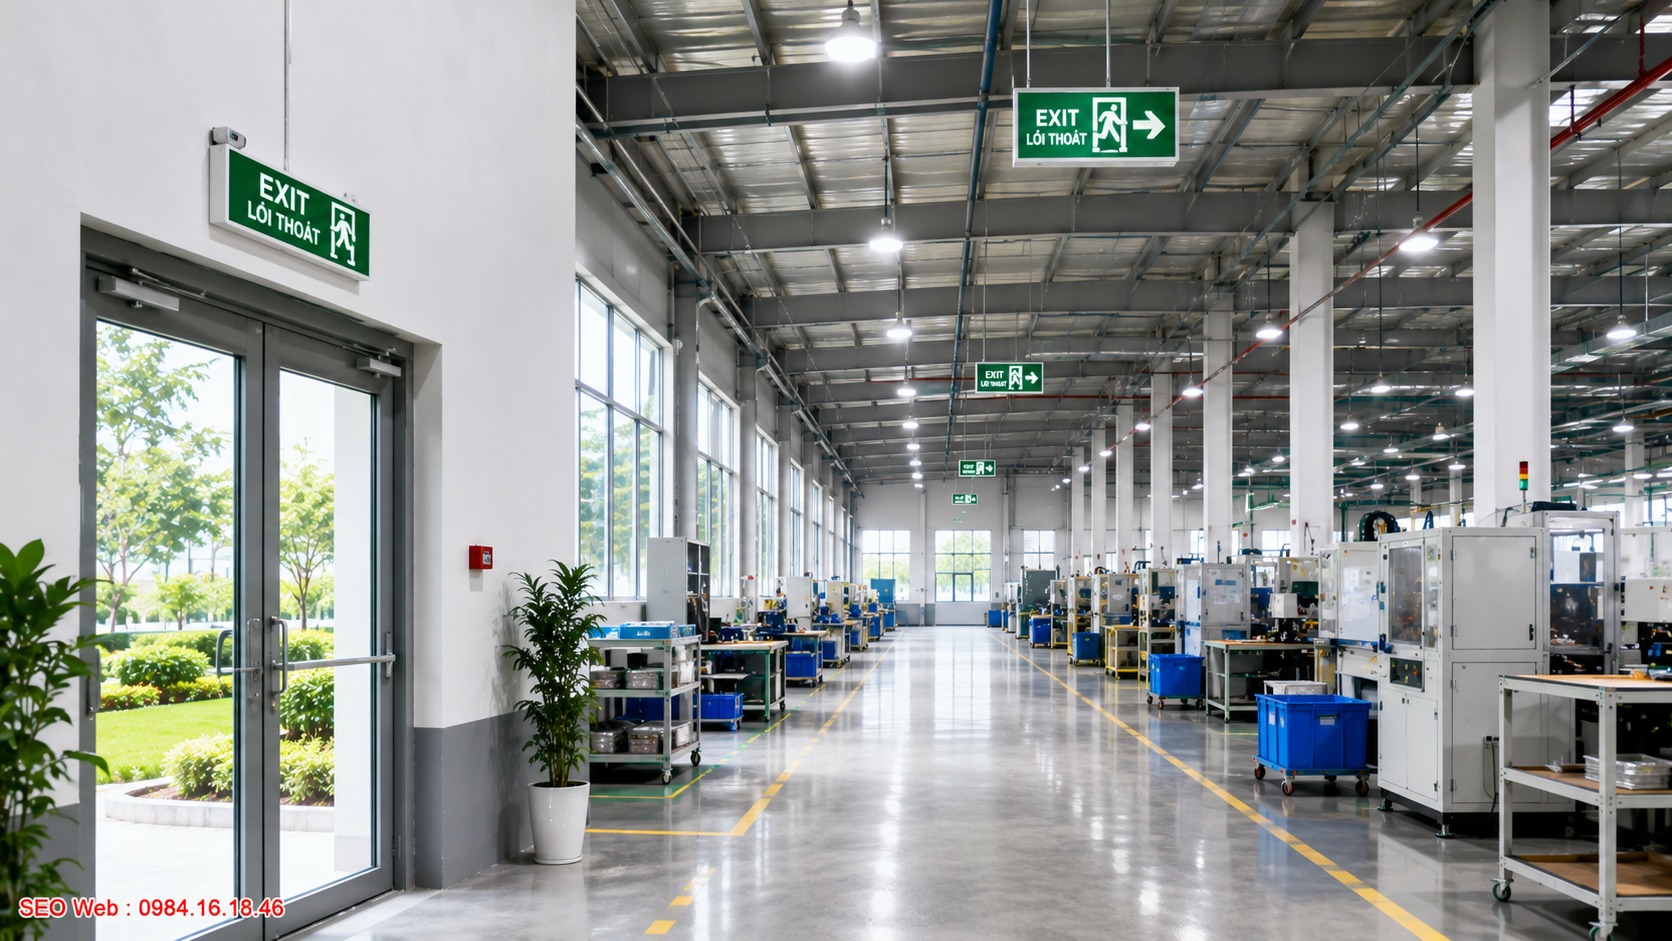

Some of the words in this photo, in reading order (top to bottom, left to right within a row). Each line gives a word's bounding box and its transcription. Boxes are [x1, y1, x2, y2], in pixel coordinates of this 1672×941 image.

[1036, 109, 1080, 127] EXIT
[259, 172, 310, 216] EXIT
[985, 370, 1004, 379] EXIT
